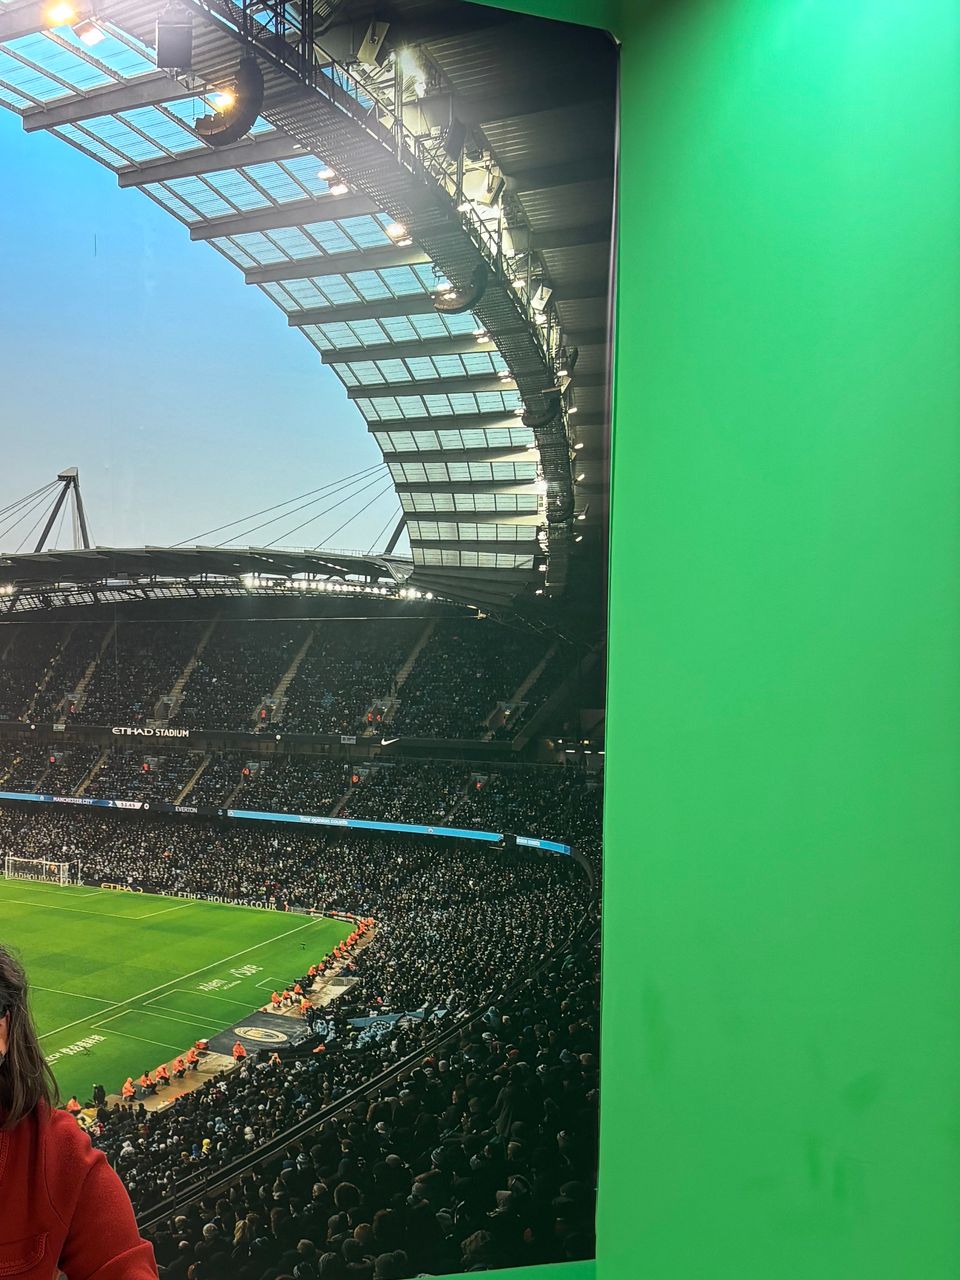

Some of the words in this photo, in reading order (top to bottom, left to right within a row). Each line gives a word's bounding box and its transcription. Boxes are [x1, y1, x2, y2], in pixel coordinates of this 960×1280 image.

[112, 727, 154, 736] ETIHAD
[155, 728, 190, 737] STADIUM
[175, 806, 198, 814] EVERTON
